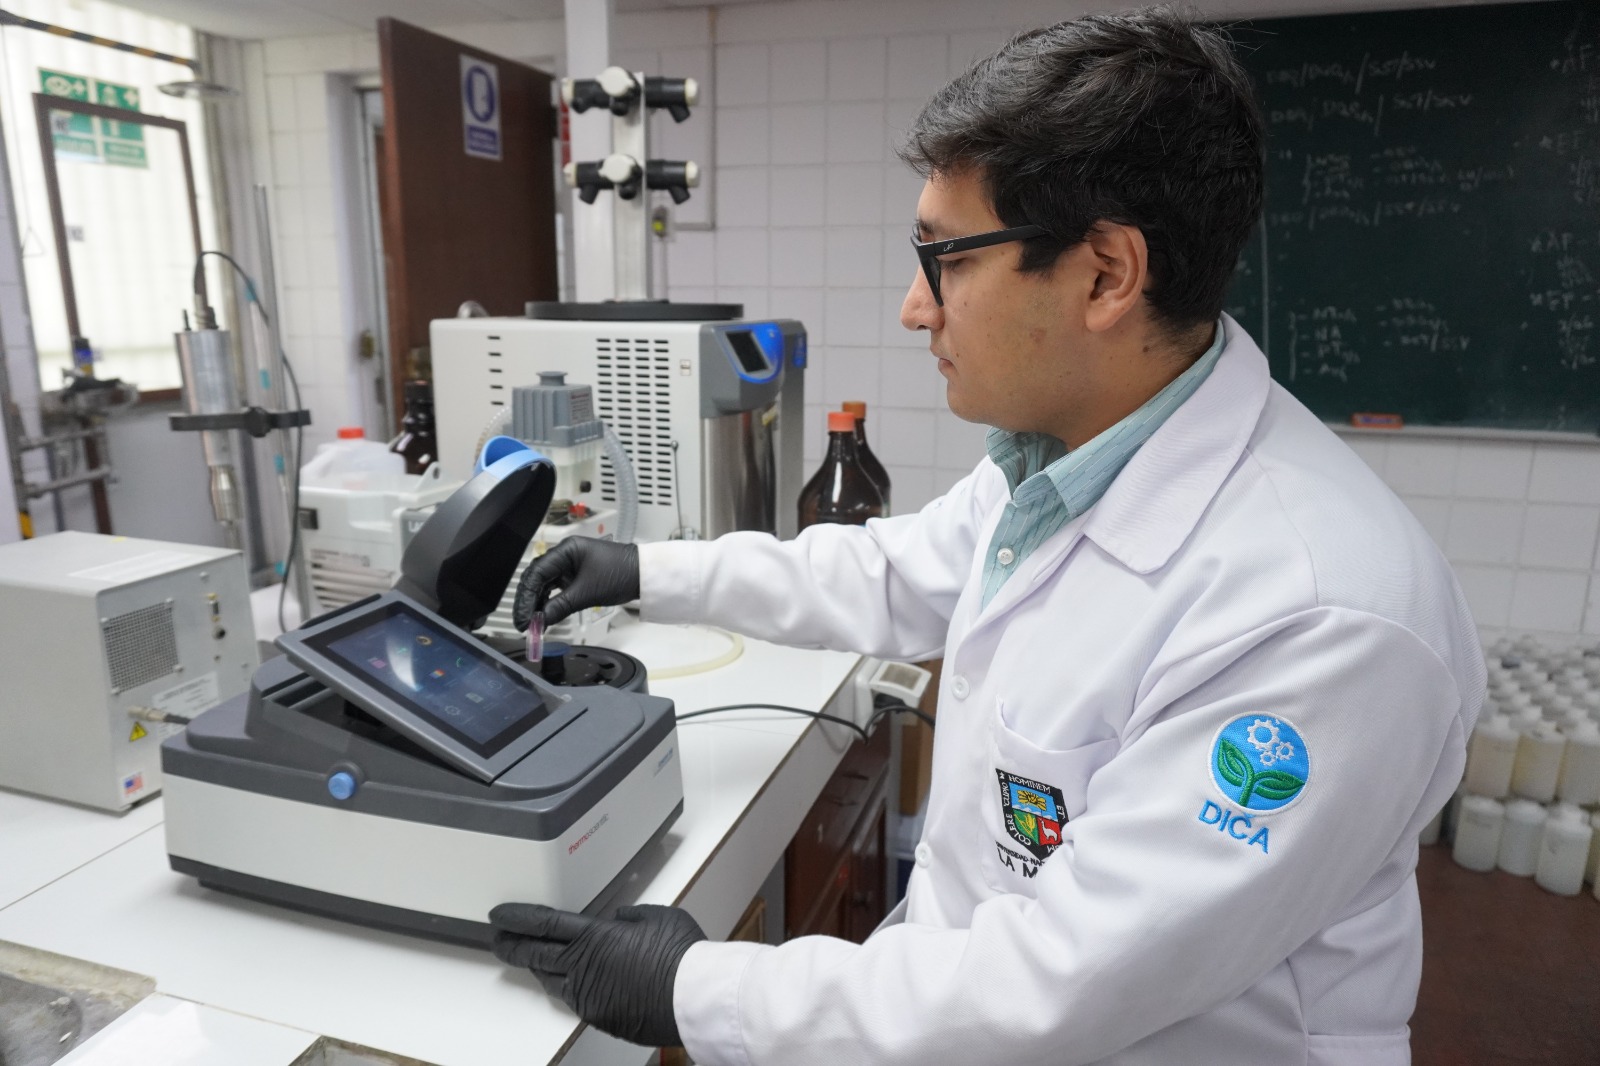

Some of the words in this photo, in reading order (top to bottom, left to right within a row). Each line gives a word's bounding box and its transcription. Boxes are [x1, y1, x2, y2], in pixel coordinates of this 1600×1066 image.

[1008, 774, 1052, 795] HOMINEM
[1056, 805, 1066, 819] ET
[1006, 813, 1032, 846] COLERE
[1198, 799, 1269, 855] DICA
[997, 847, 1016, 873] LA
